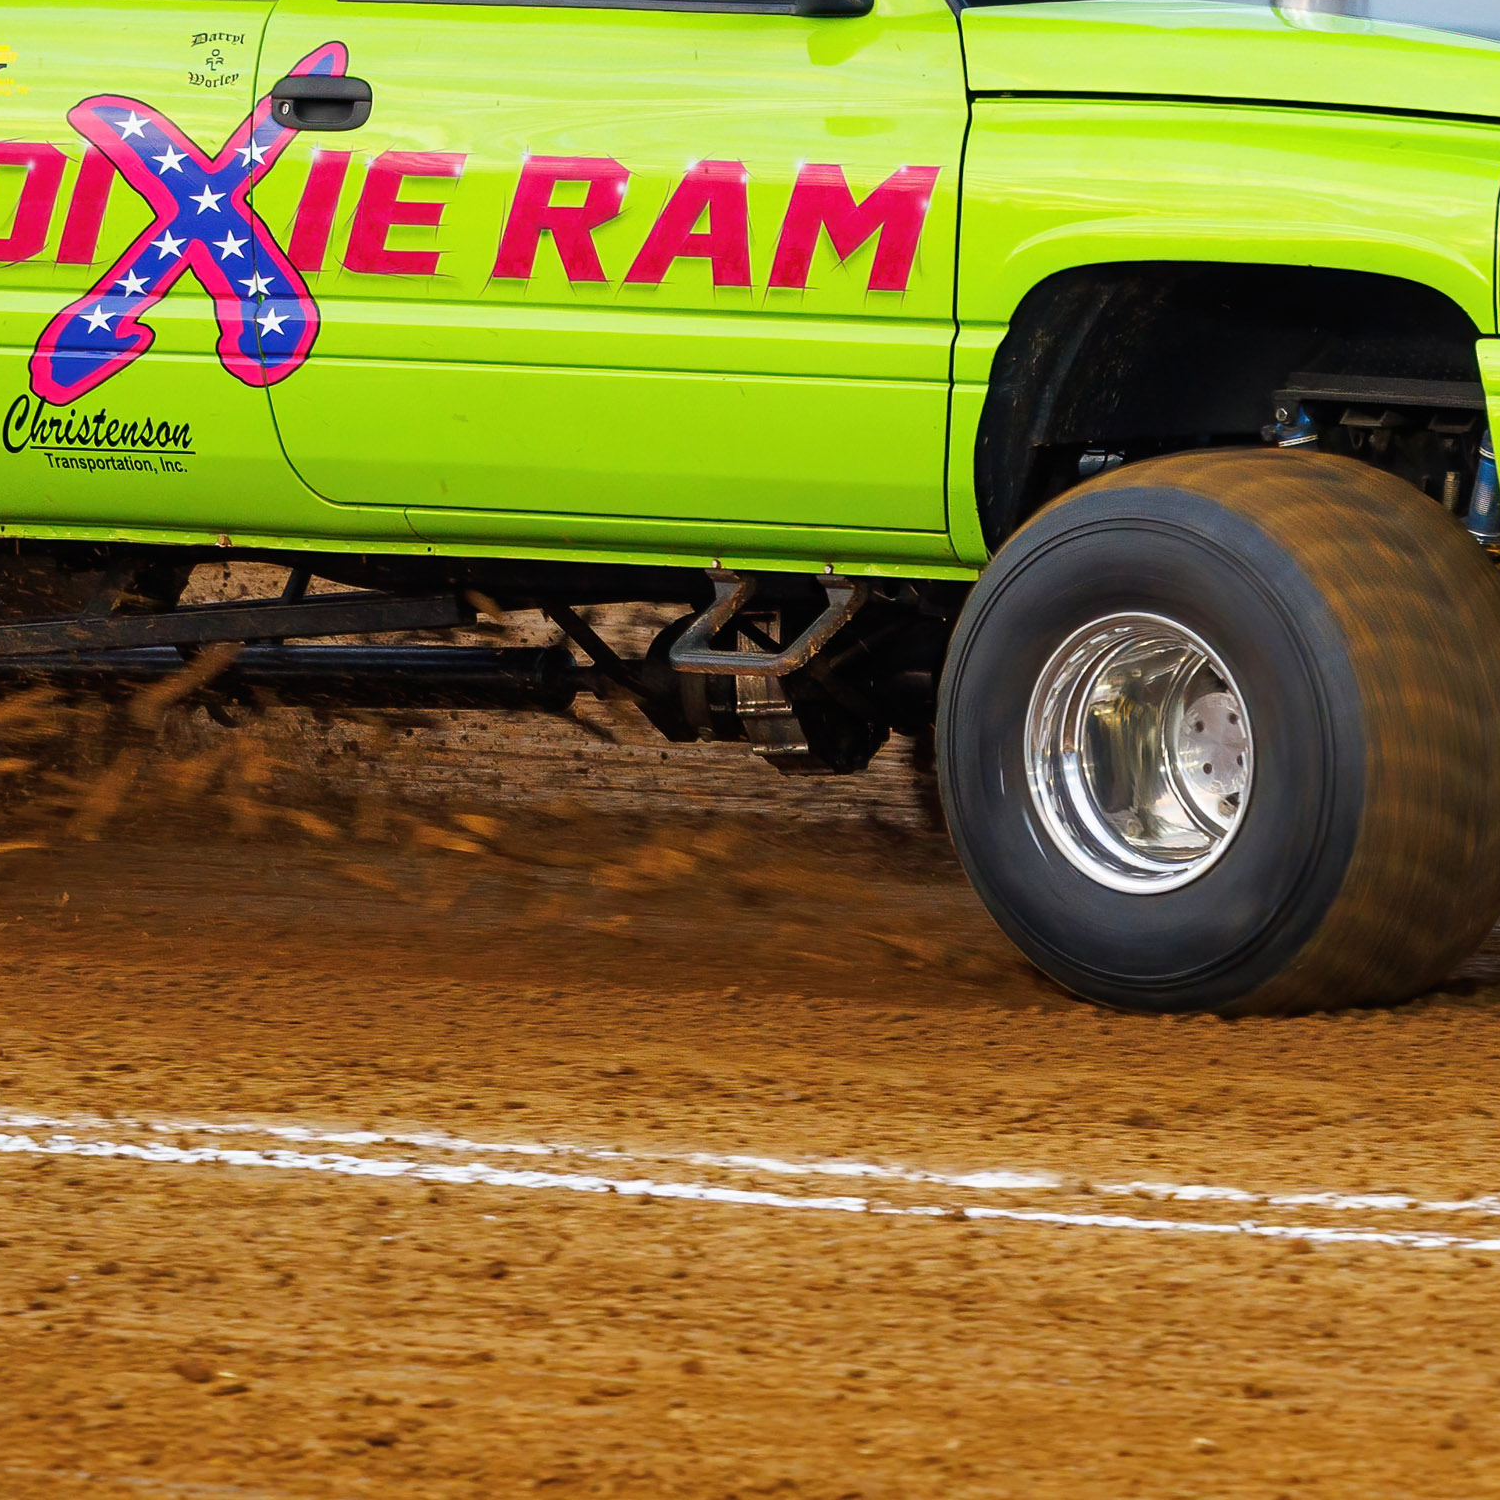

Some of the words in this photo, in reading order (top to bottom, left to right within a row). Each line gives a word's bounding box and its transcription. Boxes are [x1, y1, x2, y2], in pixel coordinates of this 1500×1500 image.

[191, 32, 246, 48] Darryl
[188, 71, 240, 88] Worley
[492, 153, 942, 293] RAM
[2, 394, 192, 453] Christenson
[44, 452, 158, 474] Transportation,
[160, 457, 188, 473] Inc.
